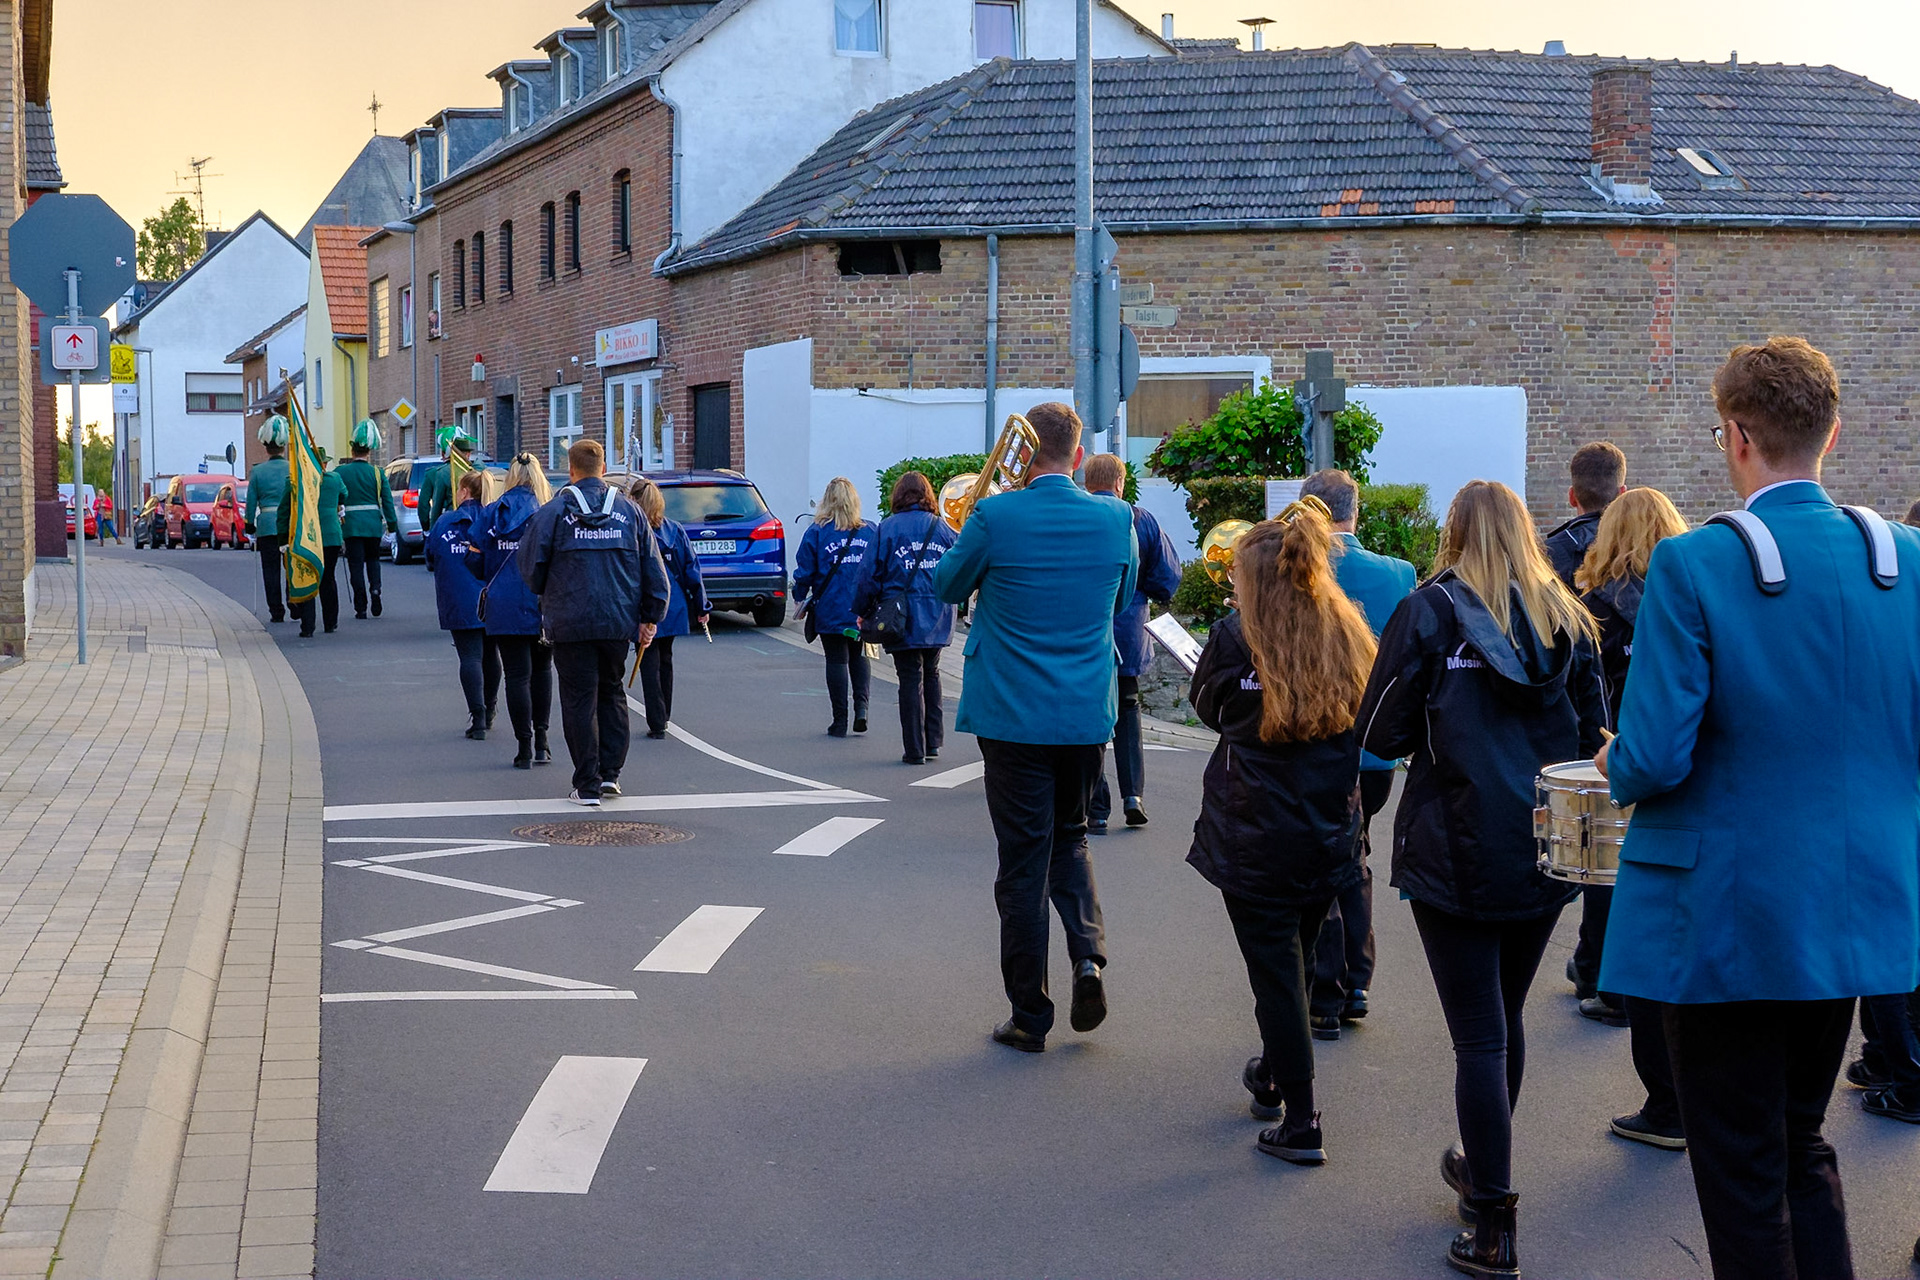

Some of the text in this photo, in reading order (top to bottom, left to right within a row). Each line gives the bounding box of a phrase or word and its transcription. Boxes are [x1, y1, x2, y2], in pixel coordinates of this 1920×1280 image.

[1134, 309, 1160, 322] Talstr.
[614, 332, 648, 351] BIKKO II
[574, 527, 622, 540] Friesheim
[825, 542, 839, 554] T.C.
[895, 546, 909, 558] T.C.
[905, 558, 941, 570] Frishei
